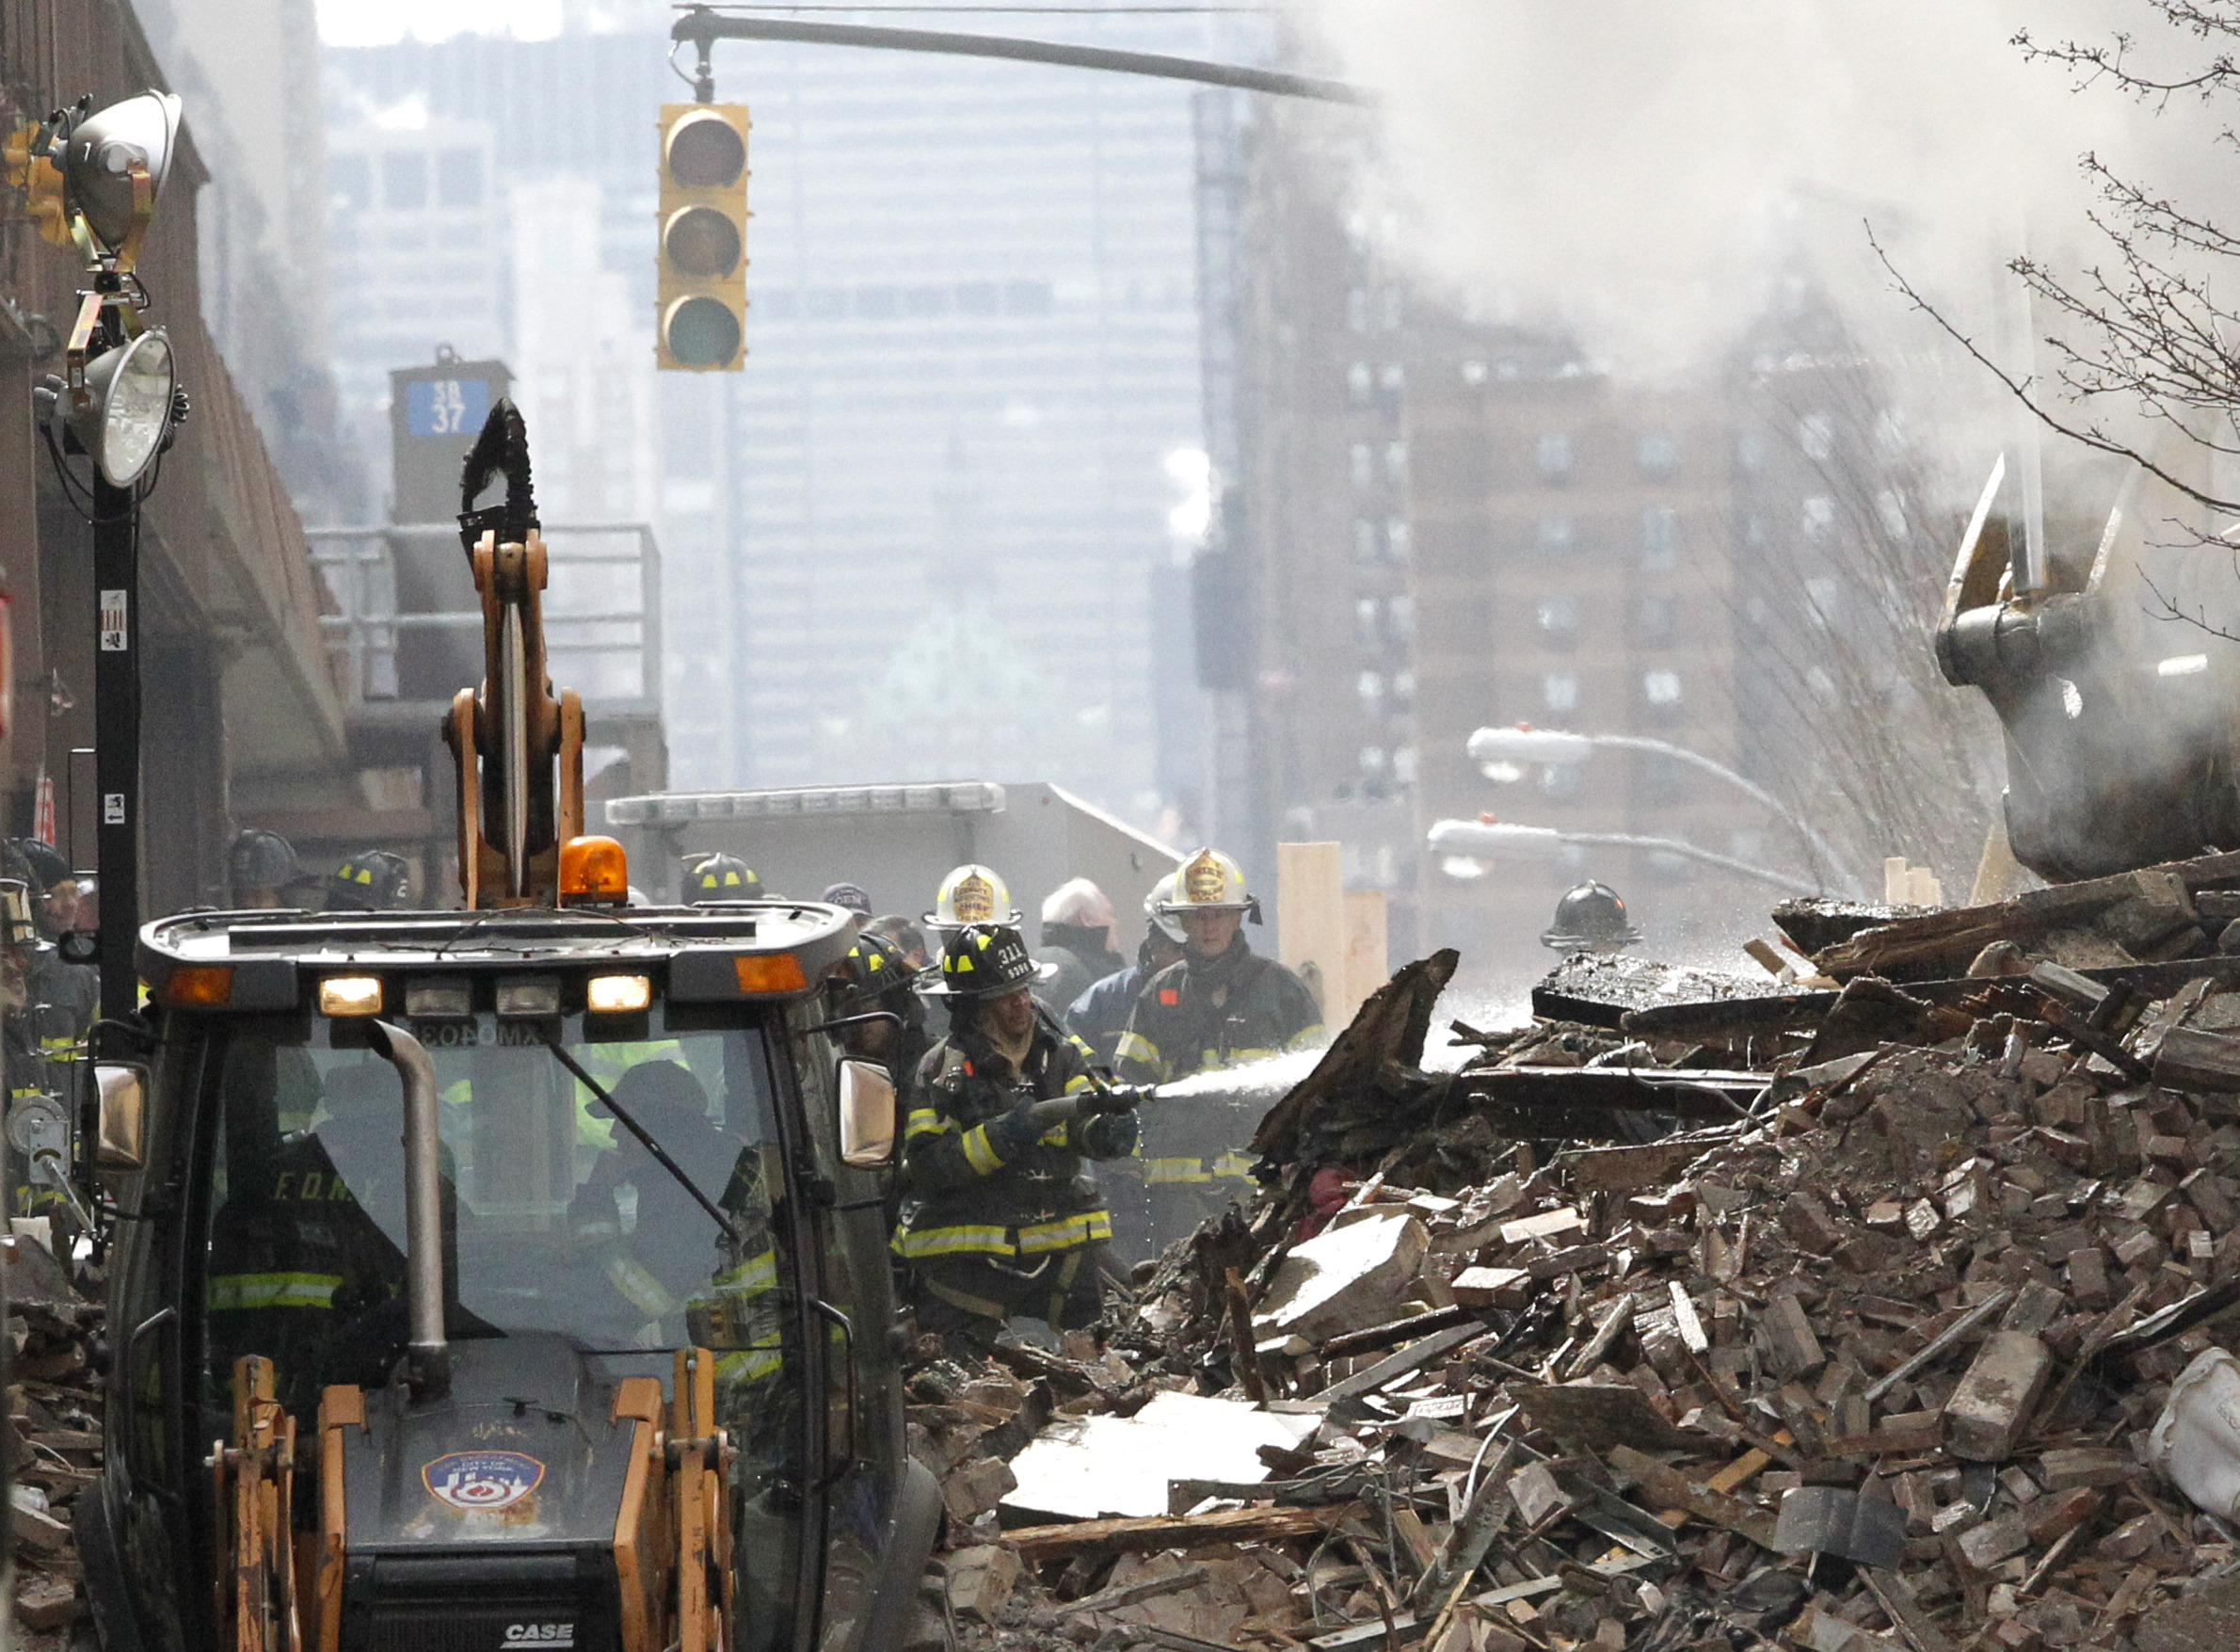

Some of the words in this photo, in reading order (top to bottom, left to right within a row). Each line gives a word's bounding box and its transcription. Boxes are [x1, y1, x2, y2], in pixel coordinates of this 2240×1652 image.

[432, 403, 466, 433] 37
[998, 943, 1023, 965] 311
[505, 1624, 574, 1640] CASE
